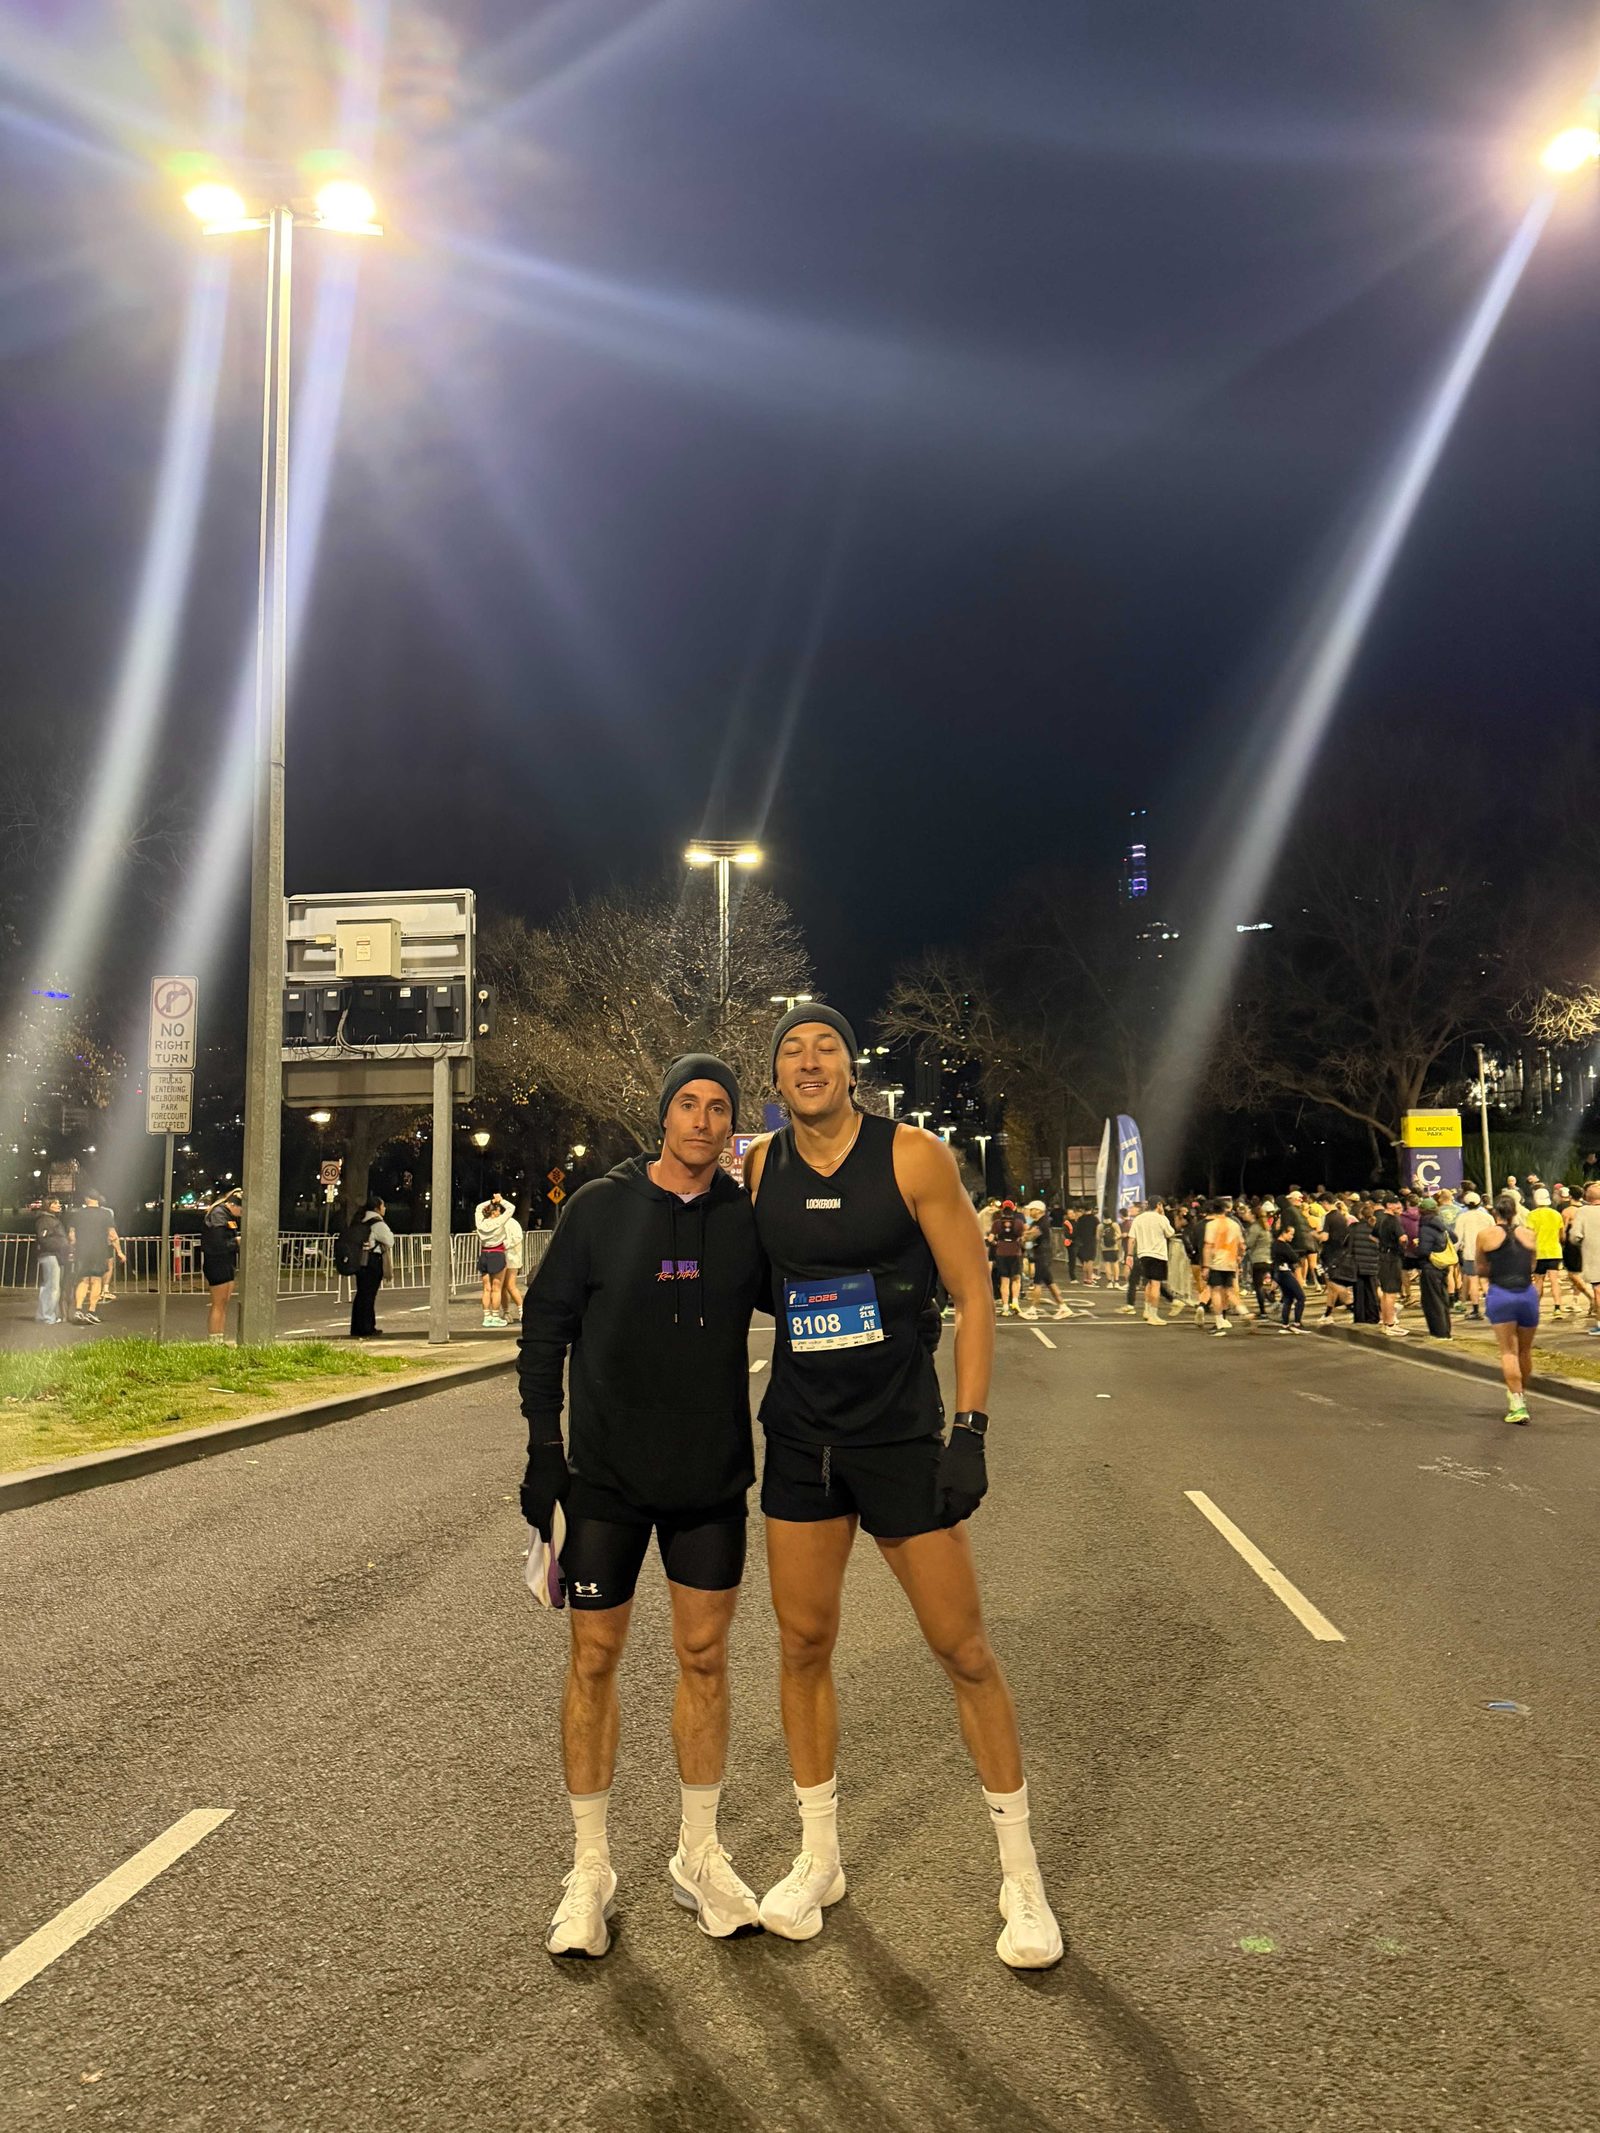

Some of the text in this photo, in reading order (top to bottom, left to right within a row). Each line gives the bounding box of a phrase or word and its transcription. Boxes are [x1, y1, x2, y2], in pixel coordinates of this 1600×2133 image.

[160, 1023, 185, 1037] NO
[155, 1040, 190, 1050] RIGHT
[155, 1054, 188, 1064] TURN
[159, 1076, 183, 1084] TRUCKS
[155, 1085, 186, 1093] ENTERING
[160, 1103, 178, 1111] PARK
[151, 1112, 187, 1120] FORECOURT
[153, 1121, 185, 1129] EXCEPTED
[739, 1139, 751, 1154] P
[719, 1155, 731, 1164] 60
[324, 1168, 336, 1177] 60
[1416, 1160, 1441, 1186] C
[792, 1313, 842, 1336] 8108
